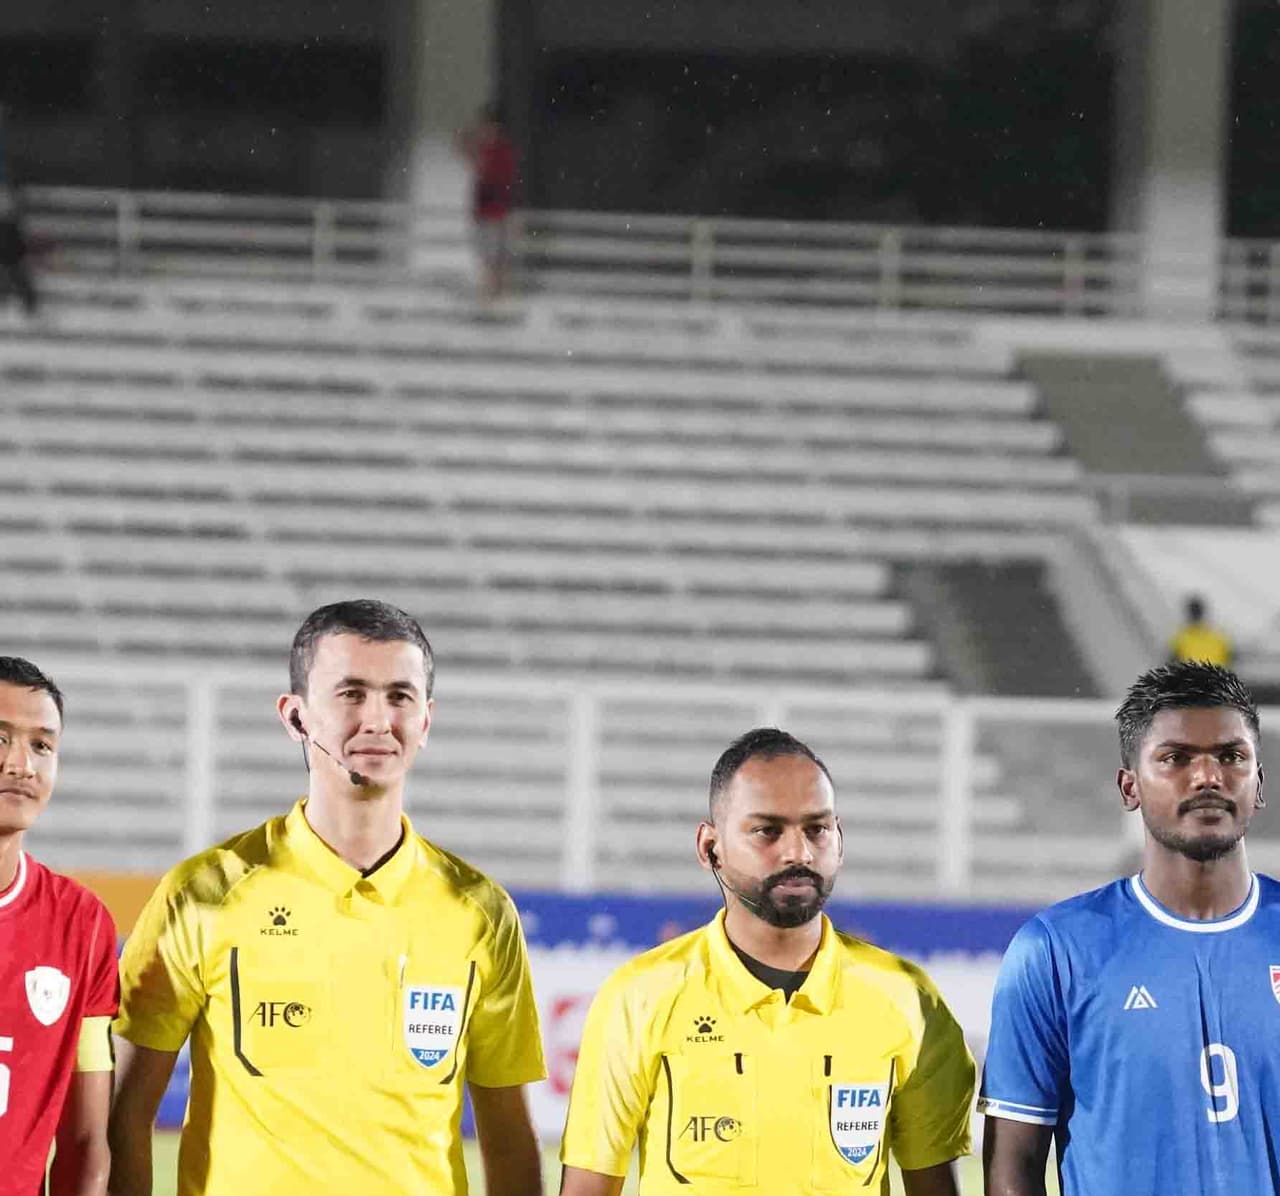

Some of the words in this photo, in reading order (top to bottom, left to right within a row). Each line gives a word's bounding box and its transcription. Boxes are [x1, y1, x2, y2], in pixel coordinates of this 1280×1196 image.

[260, 928, 300, 936] KELME
[410, 991, 455, 1011] FIFA
[408, 1023, 453, 1035] REFEREE
[686, 1035, 726, 1043] KELME
[418, 1050, 440, 1061] 2024
[1199, 1043, 1240, 1123] 9
[837, 1089, 881, 1108] FIFA
[836, 1120, 879, 1131] REFEREE
